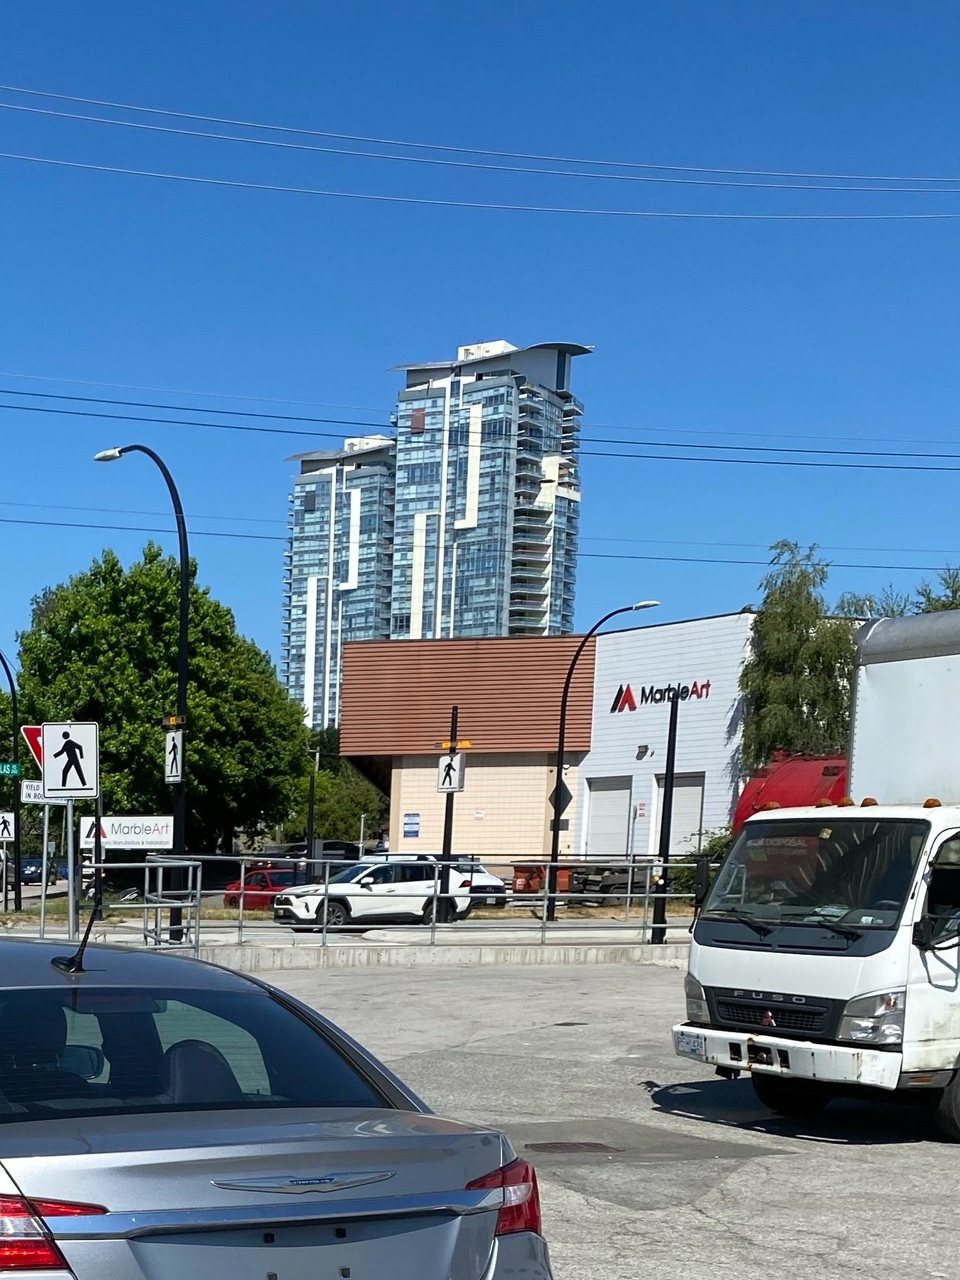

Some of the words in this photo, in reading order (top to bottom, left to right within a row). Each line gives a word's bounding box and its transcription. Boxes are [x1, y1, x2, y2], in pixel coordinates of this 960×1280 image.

[640, 679, 711, 705] MarbleArt
[111, 822, 169, 835] MarbleArt
[734, 990, 806, 1004] FUSO
